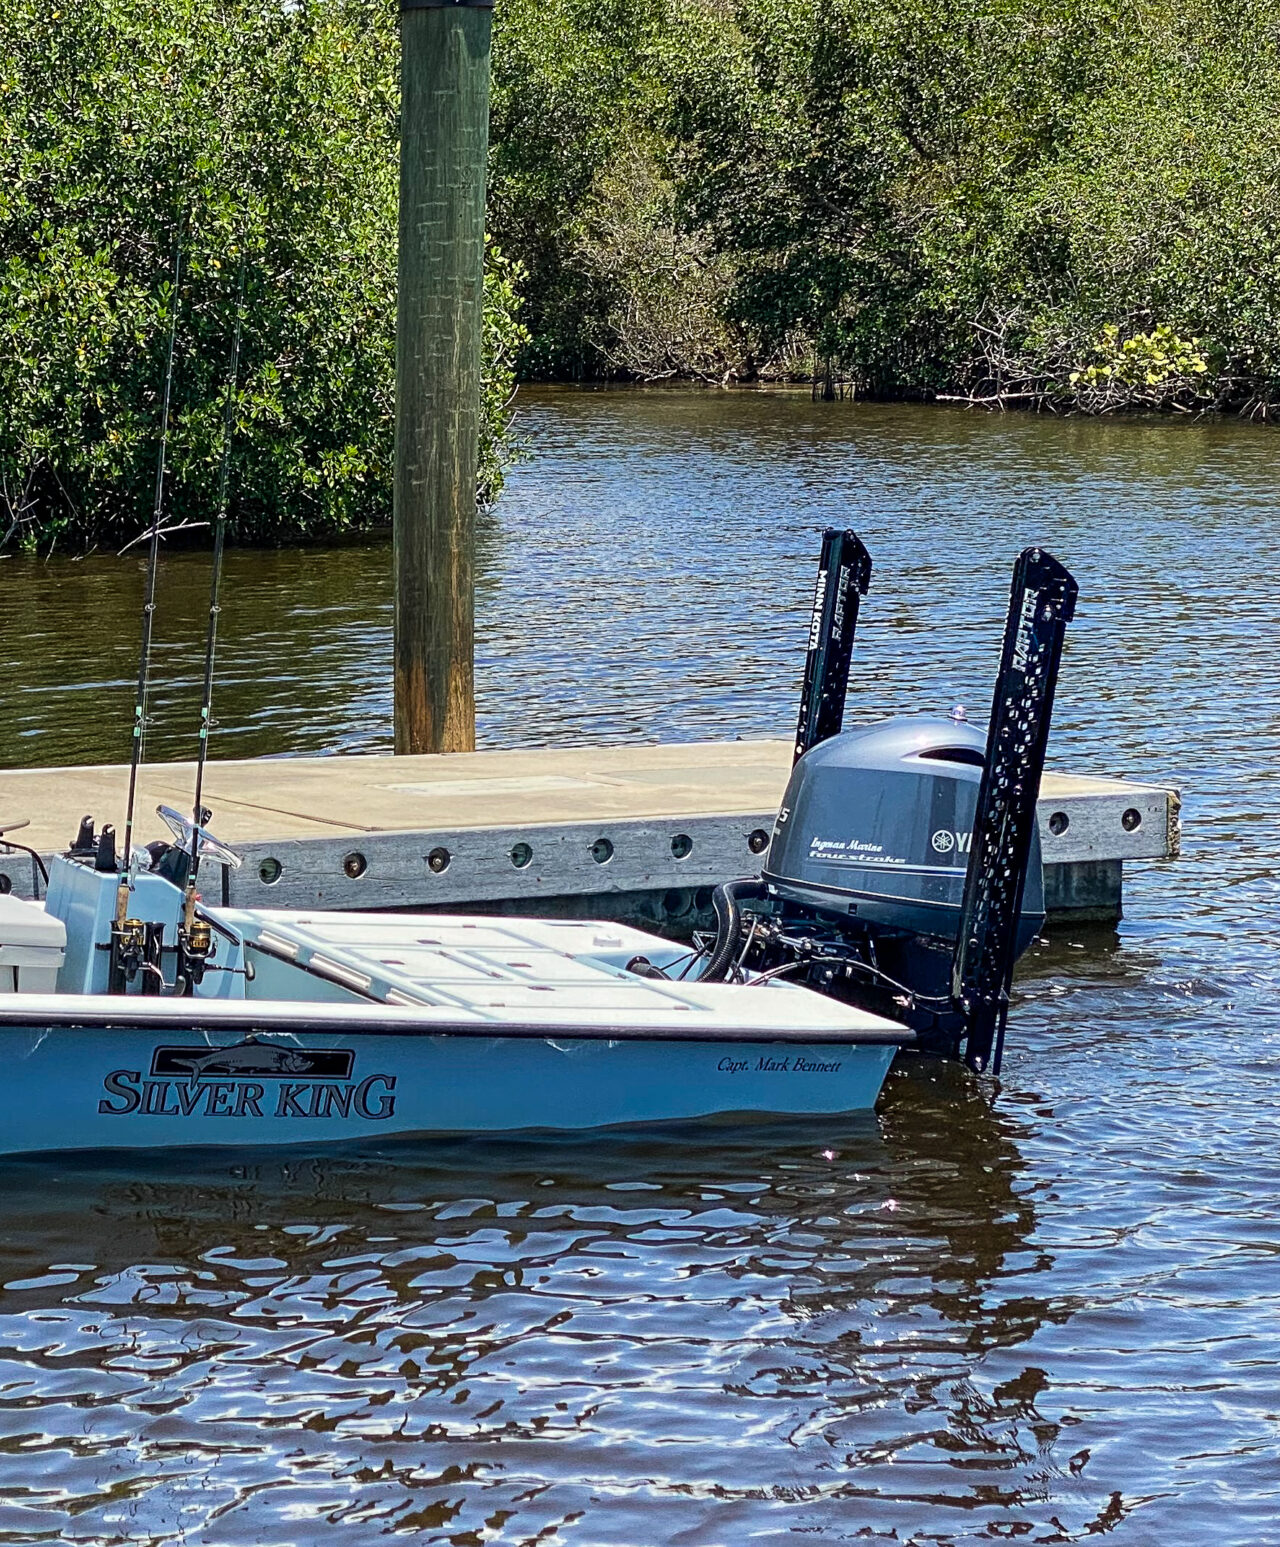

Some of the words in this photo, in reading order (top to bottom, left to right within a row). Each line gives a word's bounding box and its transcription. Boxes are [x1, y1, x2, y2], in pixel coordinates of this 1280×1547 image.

[814, 570, 828, 610] MINN
[832, 565, 850, 641] RAPTOR
[808, 612, 822, 651] KOTA
[1012, 587, 1039, 673] RAPTOR
[846, 840, 883, 853] Marine
[716, 1056, 749, 1074] Capt.
[754, 1056, 791, 1073] Mark
[792, 1057, 842, 1073] Bennett
[98, 1069, 265, 1118] SILVER
[273, 1073, 397, 1120] KING
